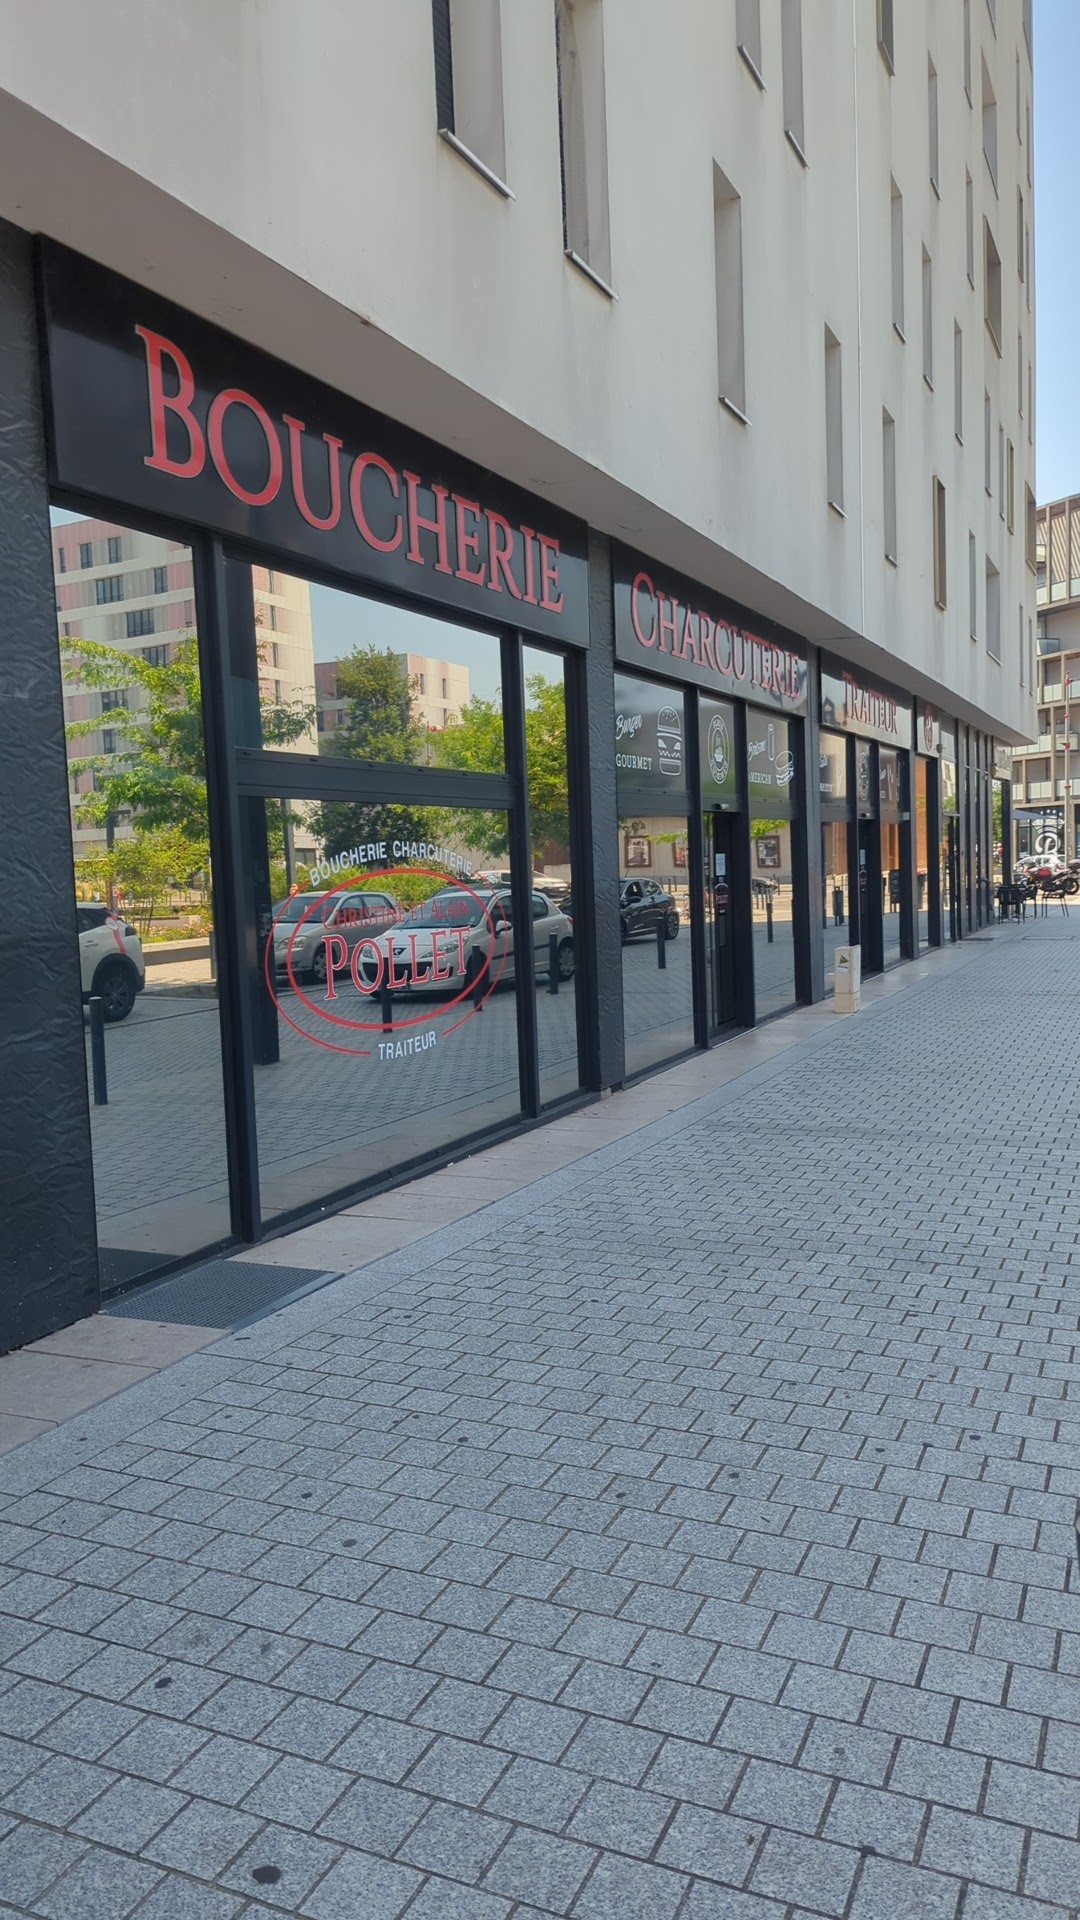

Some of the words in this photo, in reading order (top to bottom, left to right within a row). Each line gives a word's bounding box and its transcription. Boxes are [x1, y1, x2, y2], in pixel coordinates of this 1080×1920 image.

[135, 324, 563, 614] BOUCHERIE
[631, 572, 800, 699] CHARCUTERIE
[842, 671, 898, 735] TRAITEUR
[615, 714, 642, 740] Burger
[616, 753, 652, 770] GOURMET
[309, 841, 388, 887] BOUCHERIE
[393, 840, 473, 875] CHARCUTERIE
[321, 904, 404, 930] CHRISTINE
[410, 903, 427, 920] ET
[431, 899, 470, 919] ALAIN
[321, 926, 471, 1001] POLLET
[378, 1031, 437, 1061] TRAITEUR
